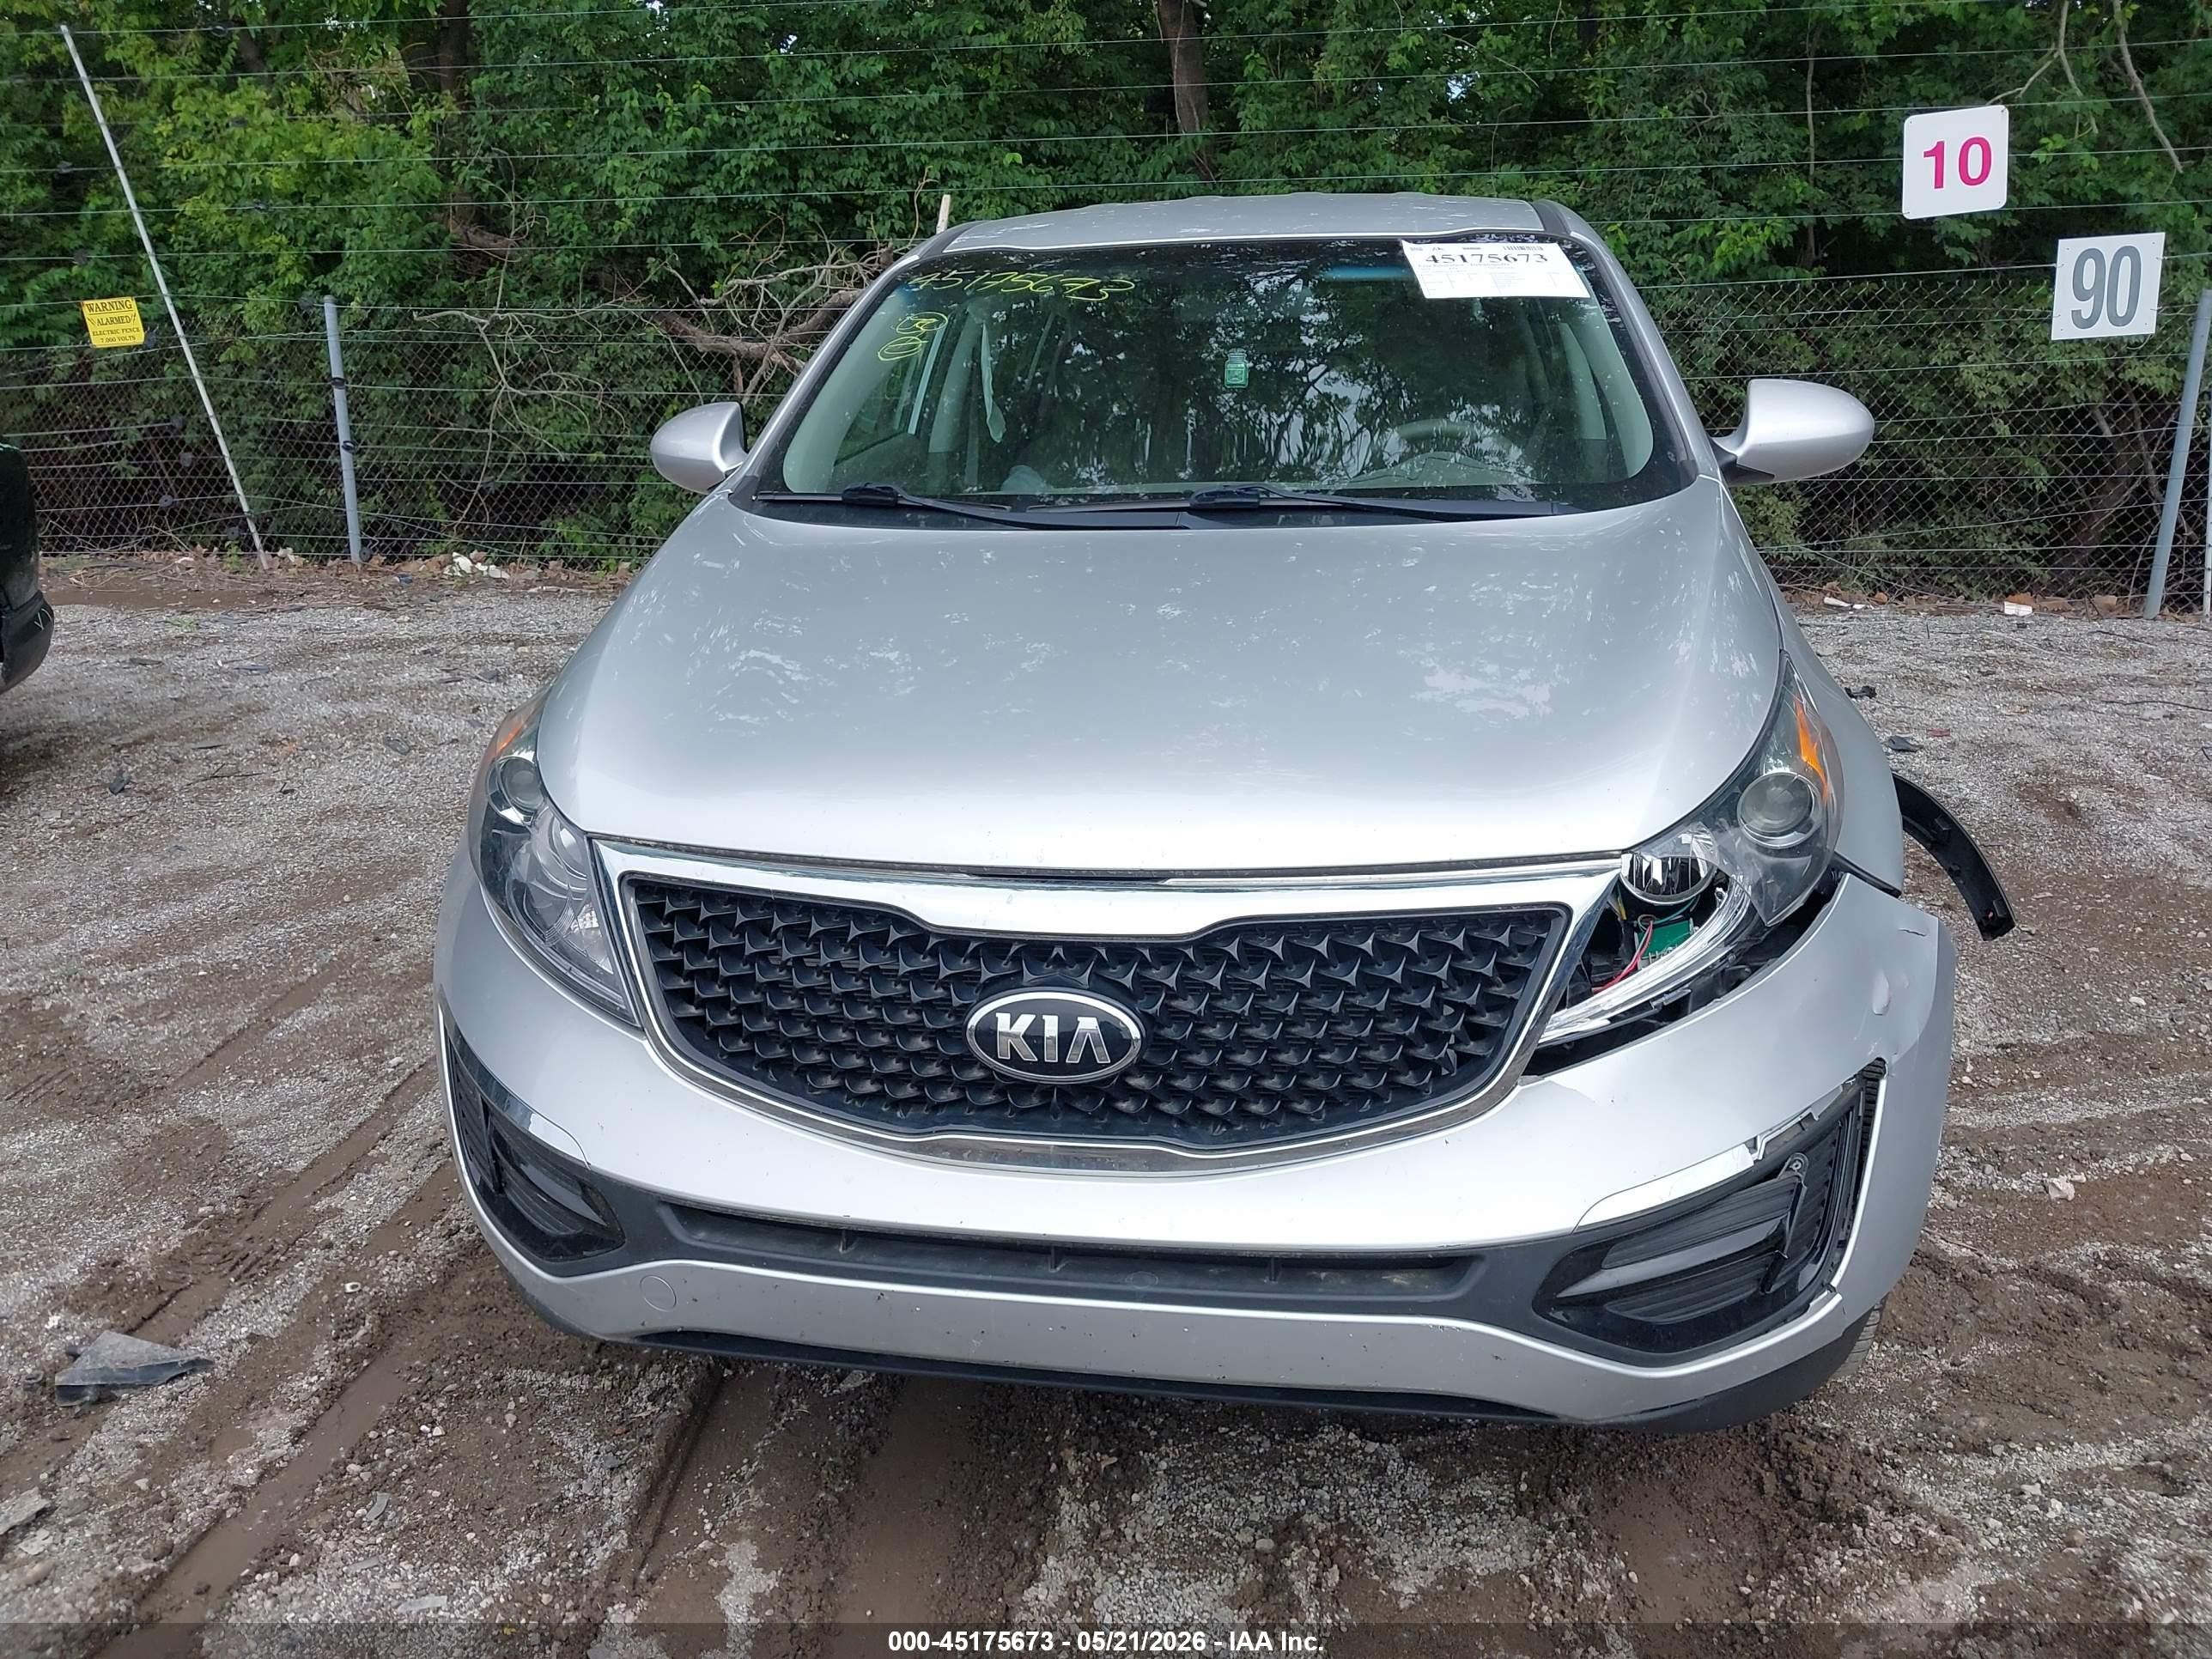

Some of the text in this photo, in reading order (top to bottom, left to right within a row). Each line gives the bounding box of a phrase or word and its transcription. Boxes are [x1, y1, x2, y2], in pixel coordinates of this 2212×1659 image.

[1923, 136, 1992, 190] 10
[1425, 253, 1548, 264] 45175673
[908, 270, 1135, 301] 45175673
[2070, 246, 2142, 330] 90
[86, 300, 132, 313] WARNING
[96, 315, 131, 326] ALARMED
[995, 1012, 1111, 1064] KIA
